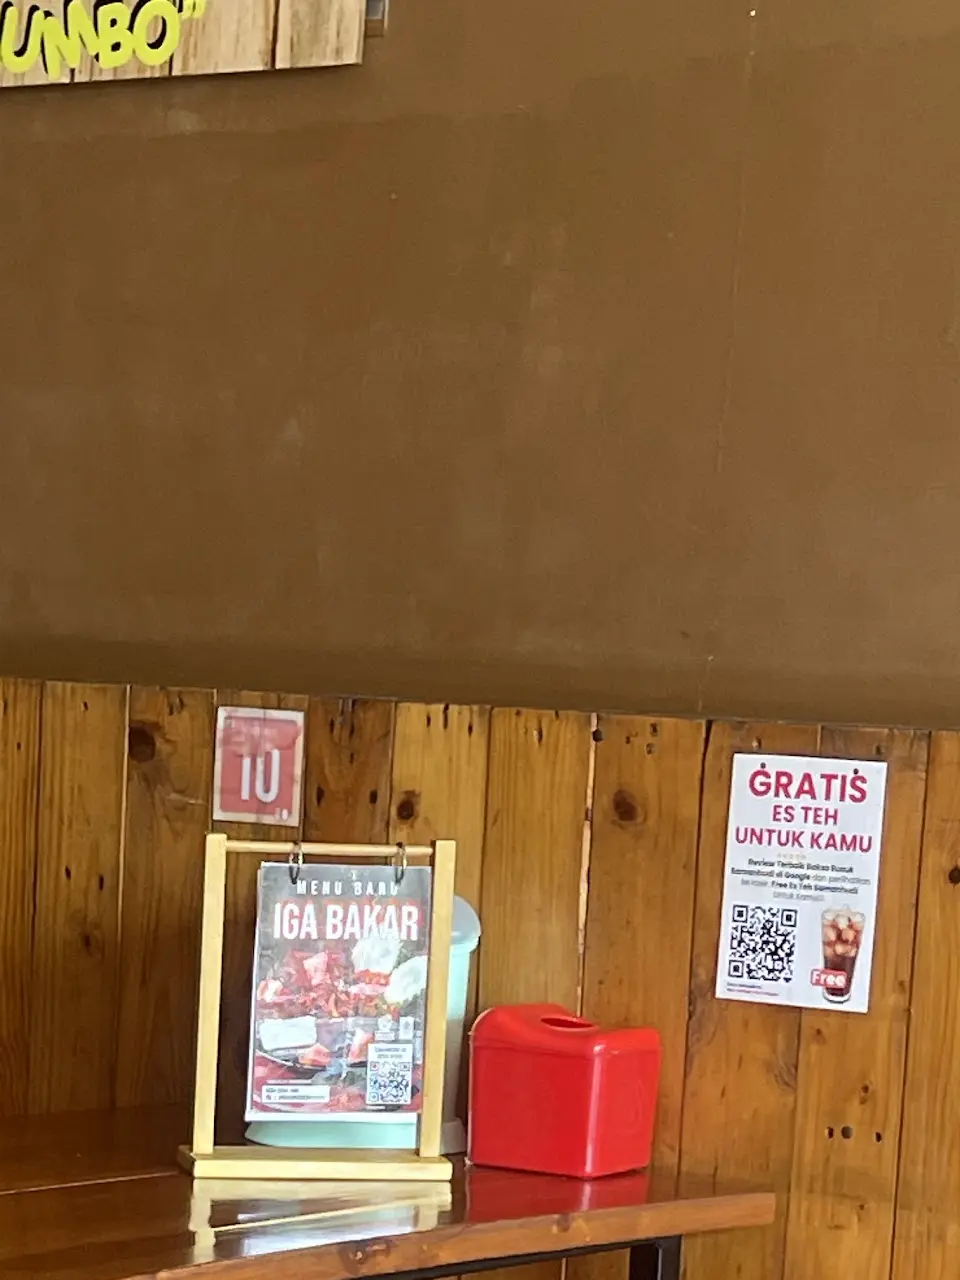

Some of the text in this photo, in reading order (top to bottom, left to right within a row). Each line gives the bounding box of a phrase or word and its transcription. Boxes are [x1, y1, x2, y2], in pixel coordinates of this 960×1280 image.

[241, 747, 280, 803] 10
[748, 768, 868, 804] GRATIS
[772, 805, 839, 826] ES TEH
[735, 826, 873, 853] UNTUK KAMU
[296, 880, 343, 896] MENU
[273, 902, 419, 941] IGA BAKAR
[812, 970, 846, 987] Free
